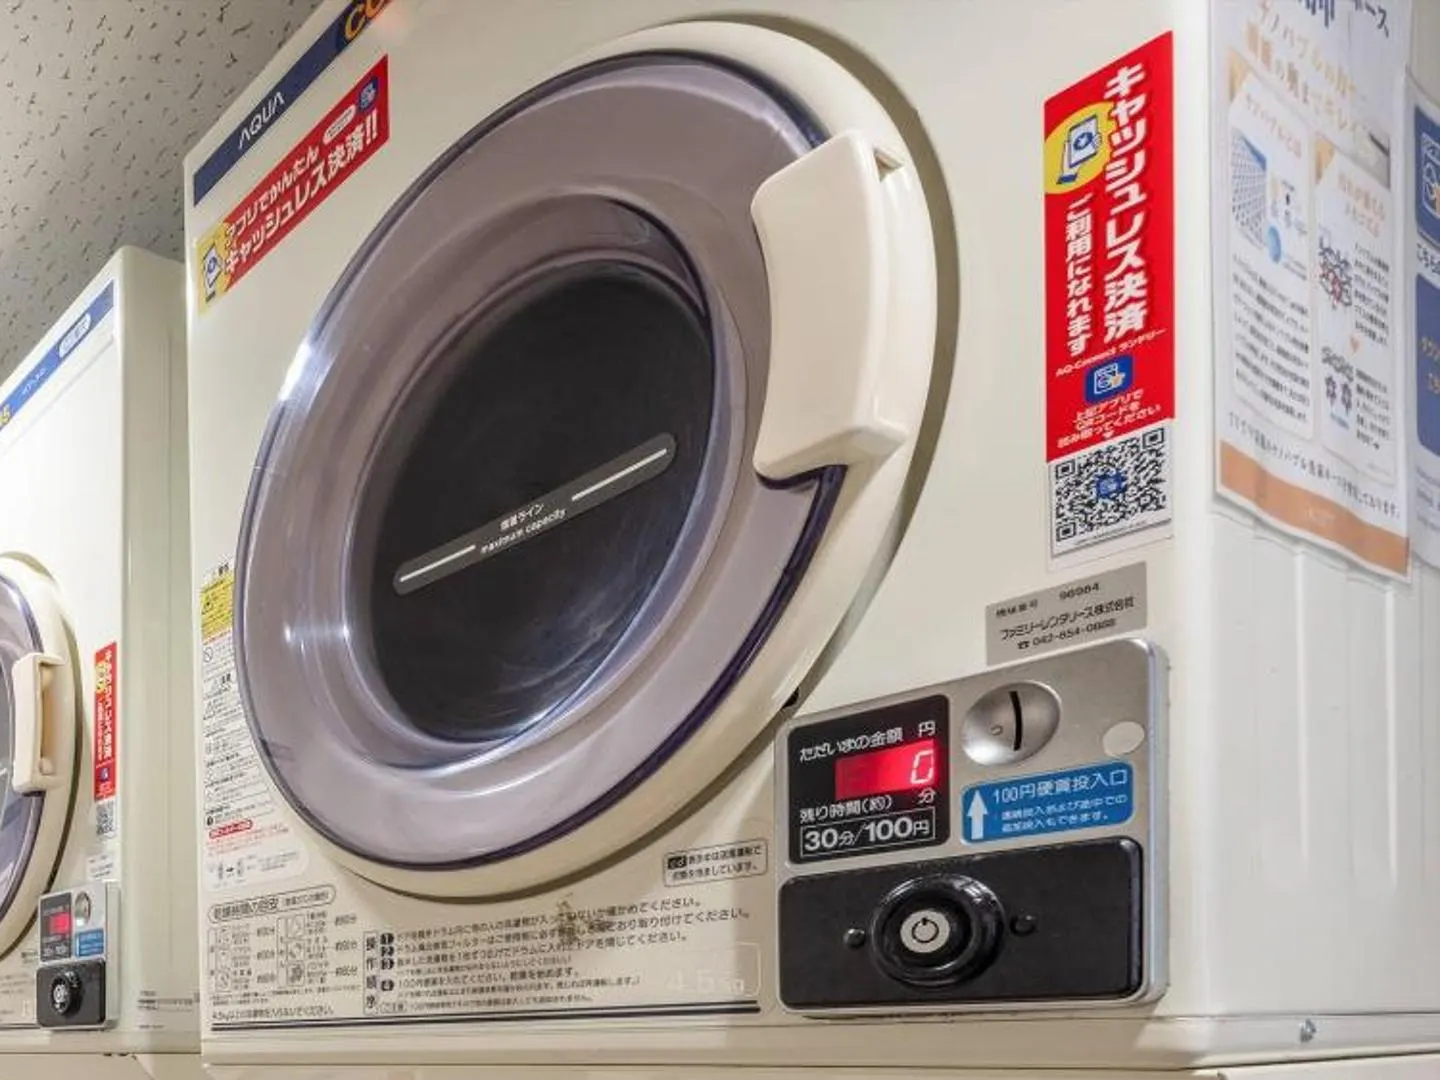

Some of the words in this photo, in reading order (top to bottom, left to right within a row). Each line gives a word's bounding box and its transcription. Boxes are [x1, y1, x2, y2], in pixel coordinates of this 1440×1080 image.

[238, 91, 285, 149] AQUA
[1104, 63, 1147, 343] キャッシュレス決済
[1066, 192, 1094, 357] ご利用になれます
[799, 727, 903, 762] ただいまの金額
[918, 721, 936, 737] 円
[910, 749, 935, 785] 0
[918, 790, 936, 805] 分
[992, 769, 1128, 805] 100円硬貨投入口
[803, 817, 931, 852] 30分/100円
